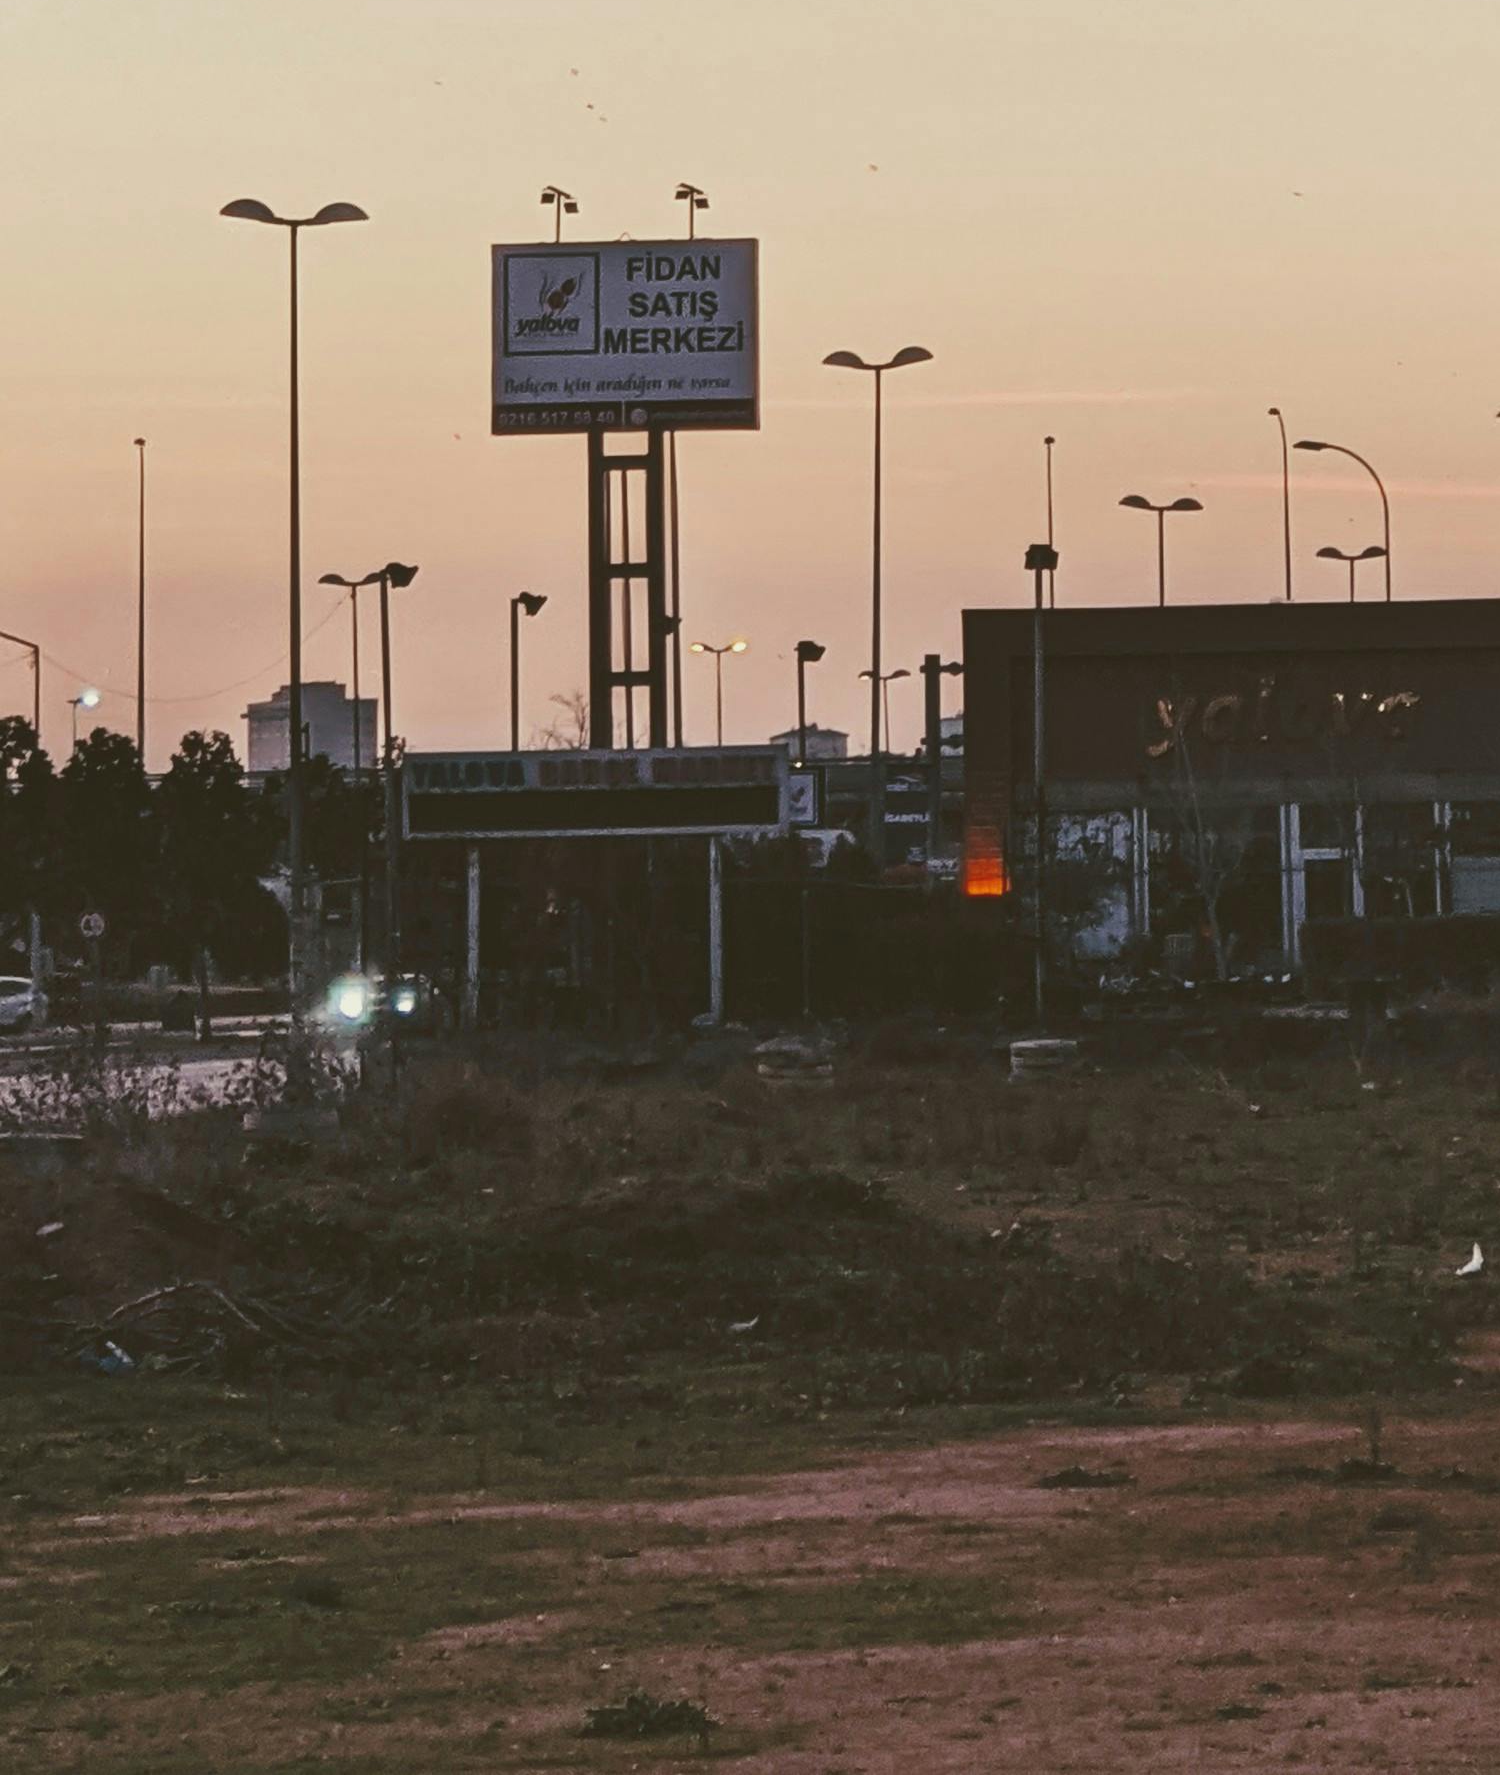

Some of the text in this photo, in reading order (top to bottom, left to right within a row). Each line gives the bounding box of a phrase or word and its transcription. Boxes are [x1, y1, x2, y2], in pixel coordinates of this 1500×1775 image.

[626, 251, 721, 282] FİDAN
[628, 290, 719, 322] SATIŞ
[514, 314, 581, 337] yalova
[603, 320, 744, 355] MERKEZİ
